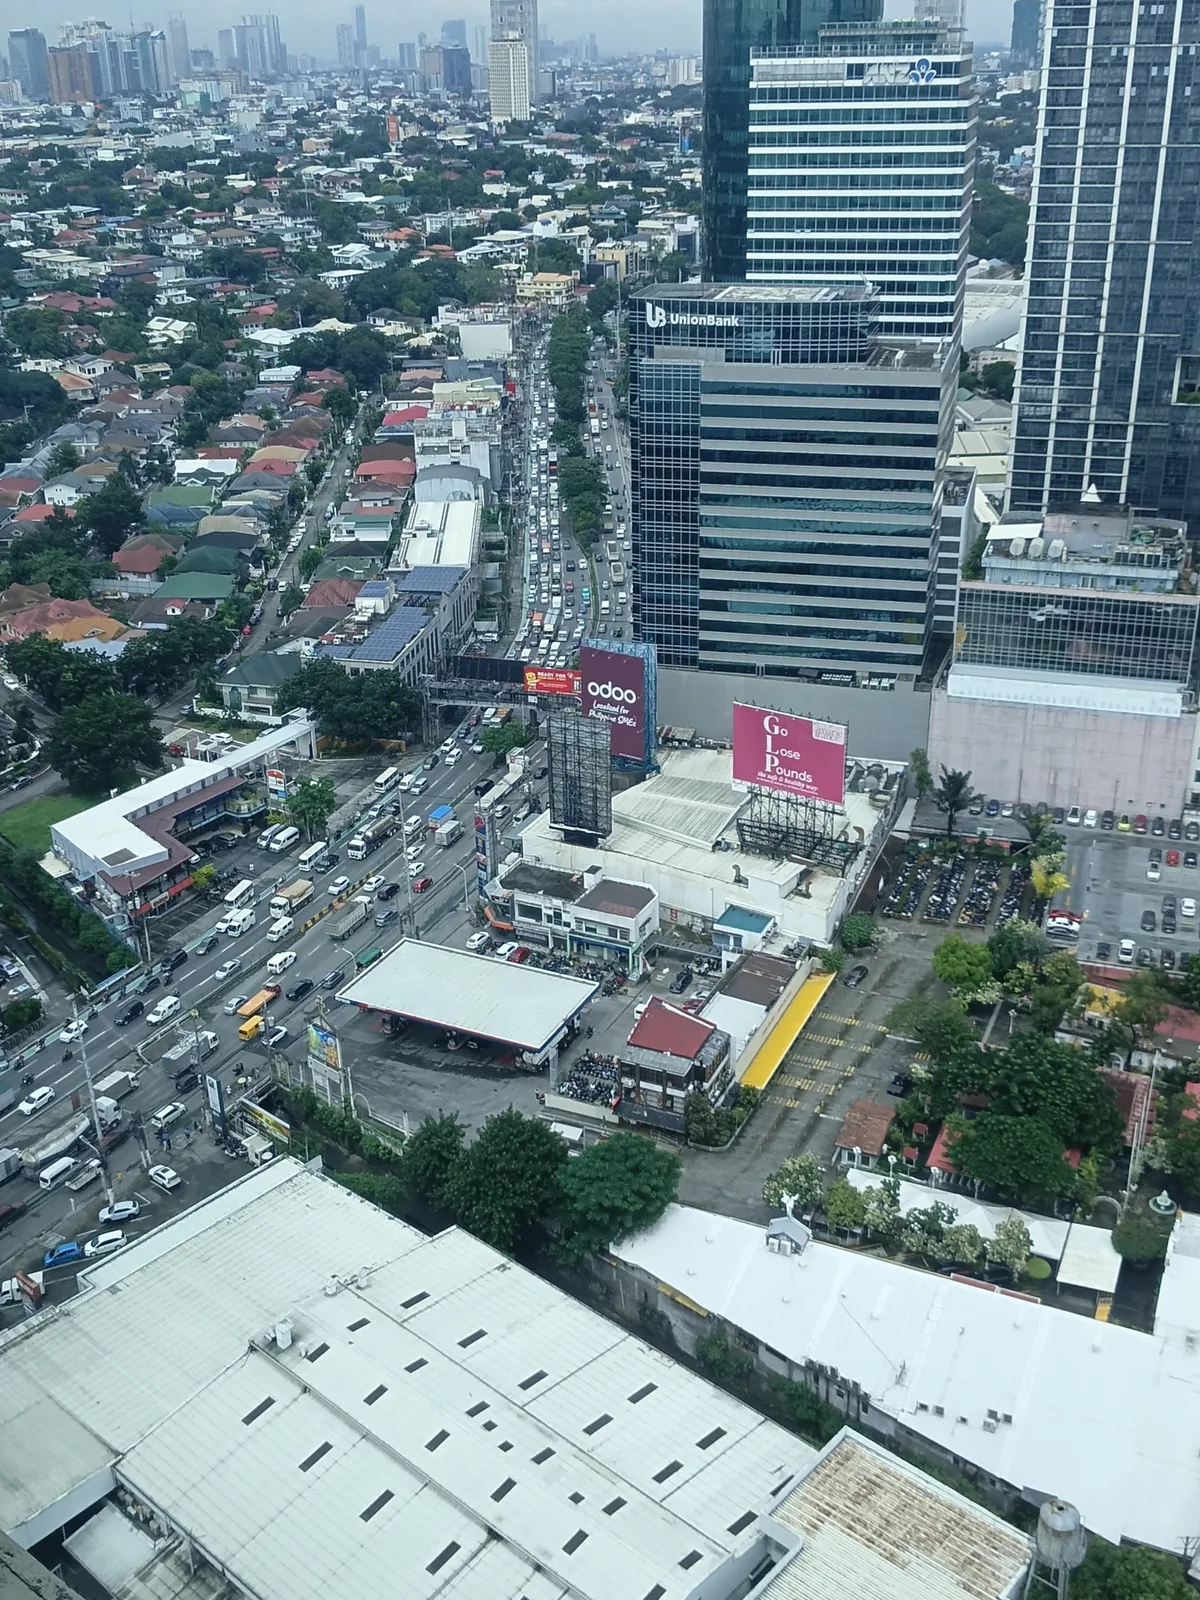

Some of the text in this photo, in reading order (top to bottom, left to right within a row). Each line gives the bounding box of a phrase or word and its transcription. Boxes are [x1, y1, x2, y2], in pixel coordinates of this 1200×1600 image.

[862, 61, 911, 85] ANZ
[670, 313, 740, 327] UnionBank
[587, 681, 637, 704] odoo
[593, 699, 629, 714] Localized for
[763, 715, 788, 736] Go
[765, 734, 801, 760] Lose
[765, 753, 813, 783] Pounds
[784, 777, 805, 789] healthy
[806, 783, 818, 791] way
